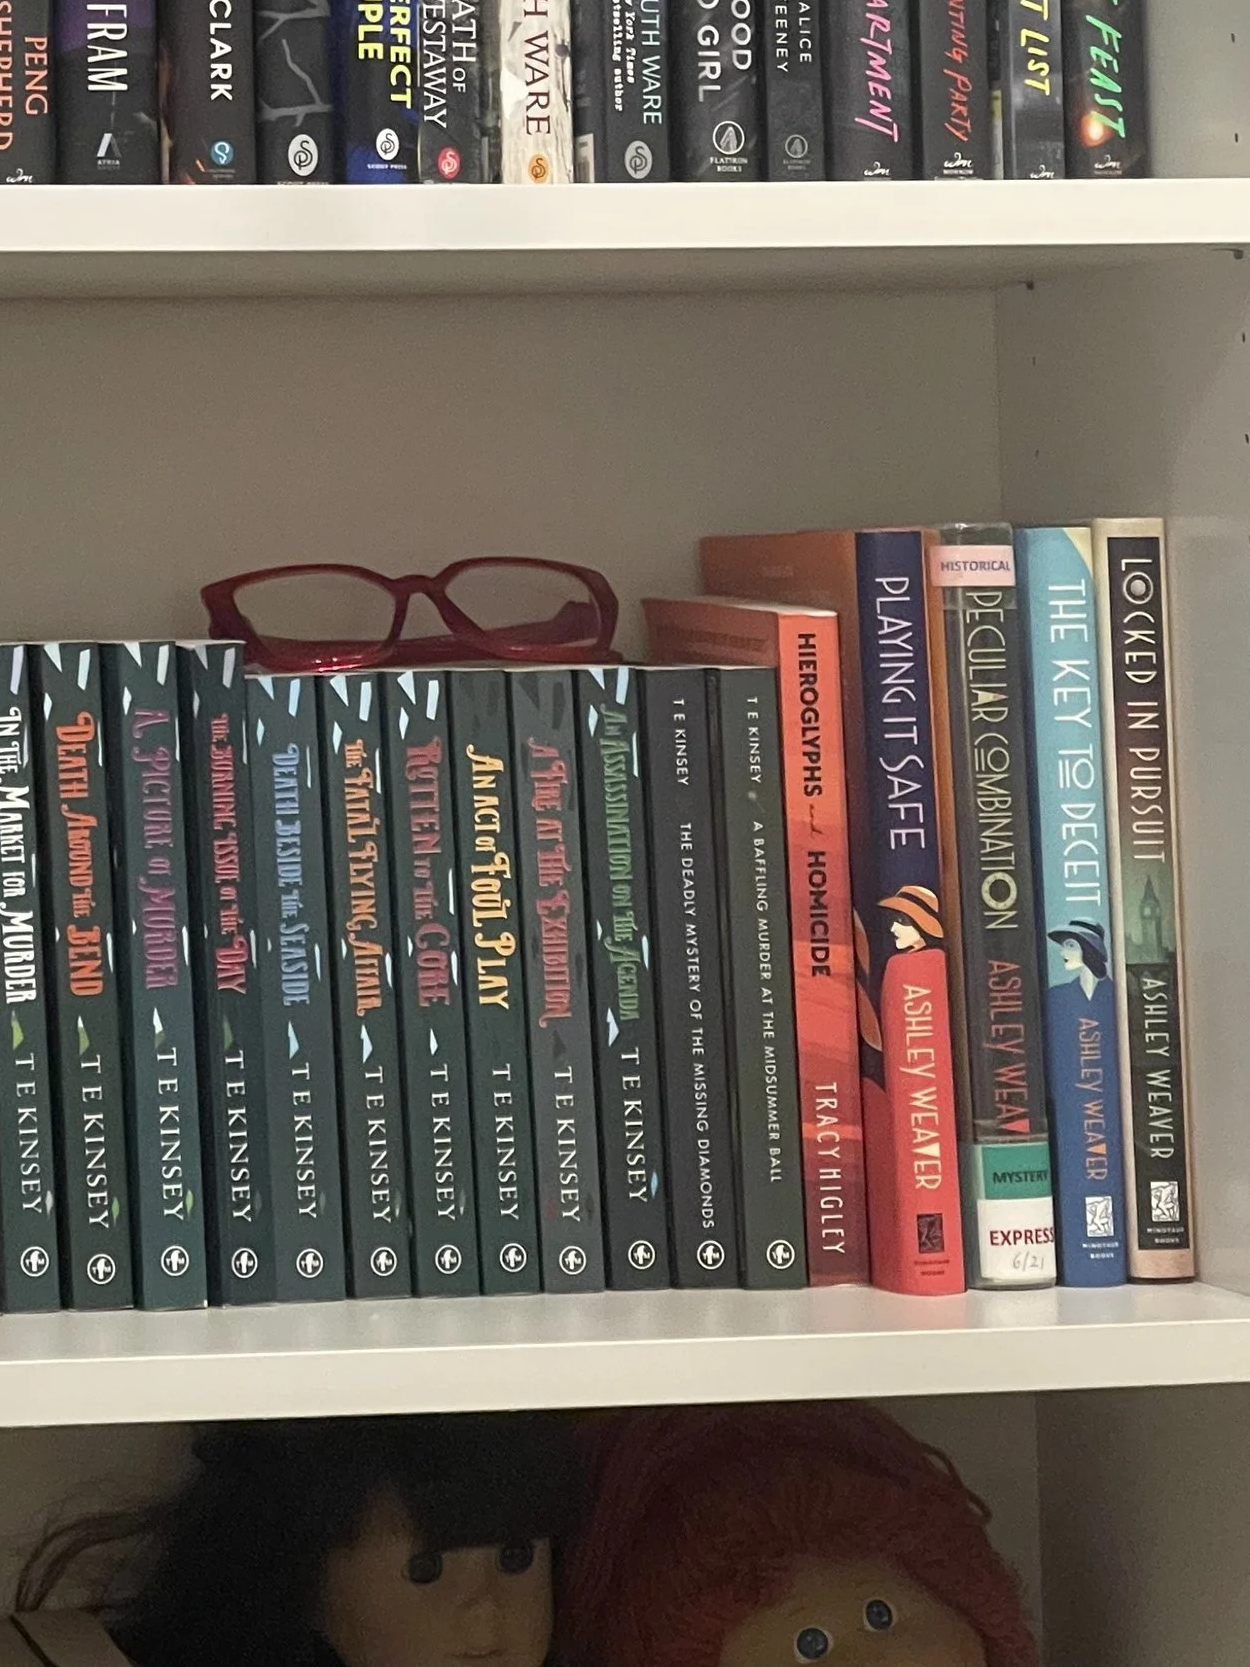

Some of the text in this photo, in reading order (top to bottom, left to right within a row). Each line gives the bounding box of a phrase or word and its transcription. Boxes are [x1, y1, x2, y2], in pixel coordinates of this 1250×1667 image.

[24, 36, 48, 116] PENG
[86, 3, 128, 91] FRAM
[523, 30, 550, 135] WARE
[697, 25, 721, 103] GIRL
[798, 1, 812, 63] ALICE
[940, 561, 1010, 571] HISTORICAL
[875, 577, 925, 849] PLAYING IT SAFE
[966, 591, 1019, 930] PECULIAR COMBINATION
[1048, 579, 1101, 905] THE KEY TO DECEIT
[1121, 558, 1165, 862] LOCKED IN PURSUIT
[798, 633, 831, 977] HIEROGLYPHS HOMICIDE
[674, 730, 714, 1228] KINSEY THE DEADLY MYSTERY OF THE MISSING DIAMONDS
[748, 727, 781, 1182] KINSEY BAFFLING MURDER MIDSUMMER BALL
[900, 984, 942, 1190] ASHLEY WEAVER
[1142, 976, 1173, 1159] ASHLEY WEAVER
[815, 1083, 845, 1253] TRACY HIGLEY
[990, 1227, 1055, 1246] EXPRESS
